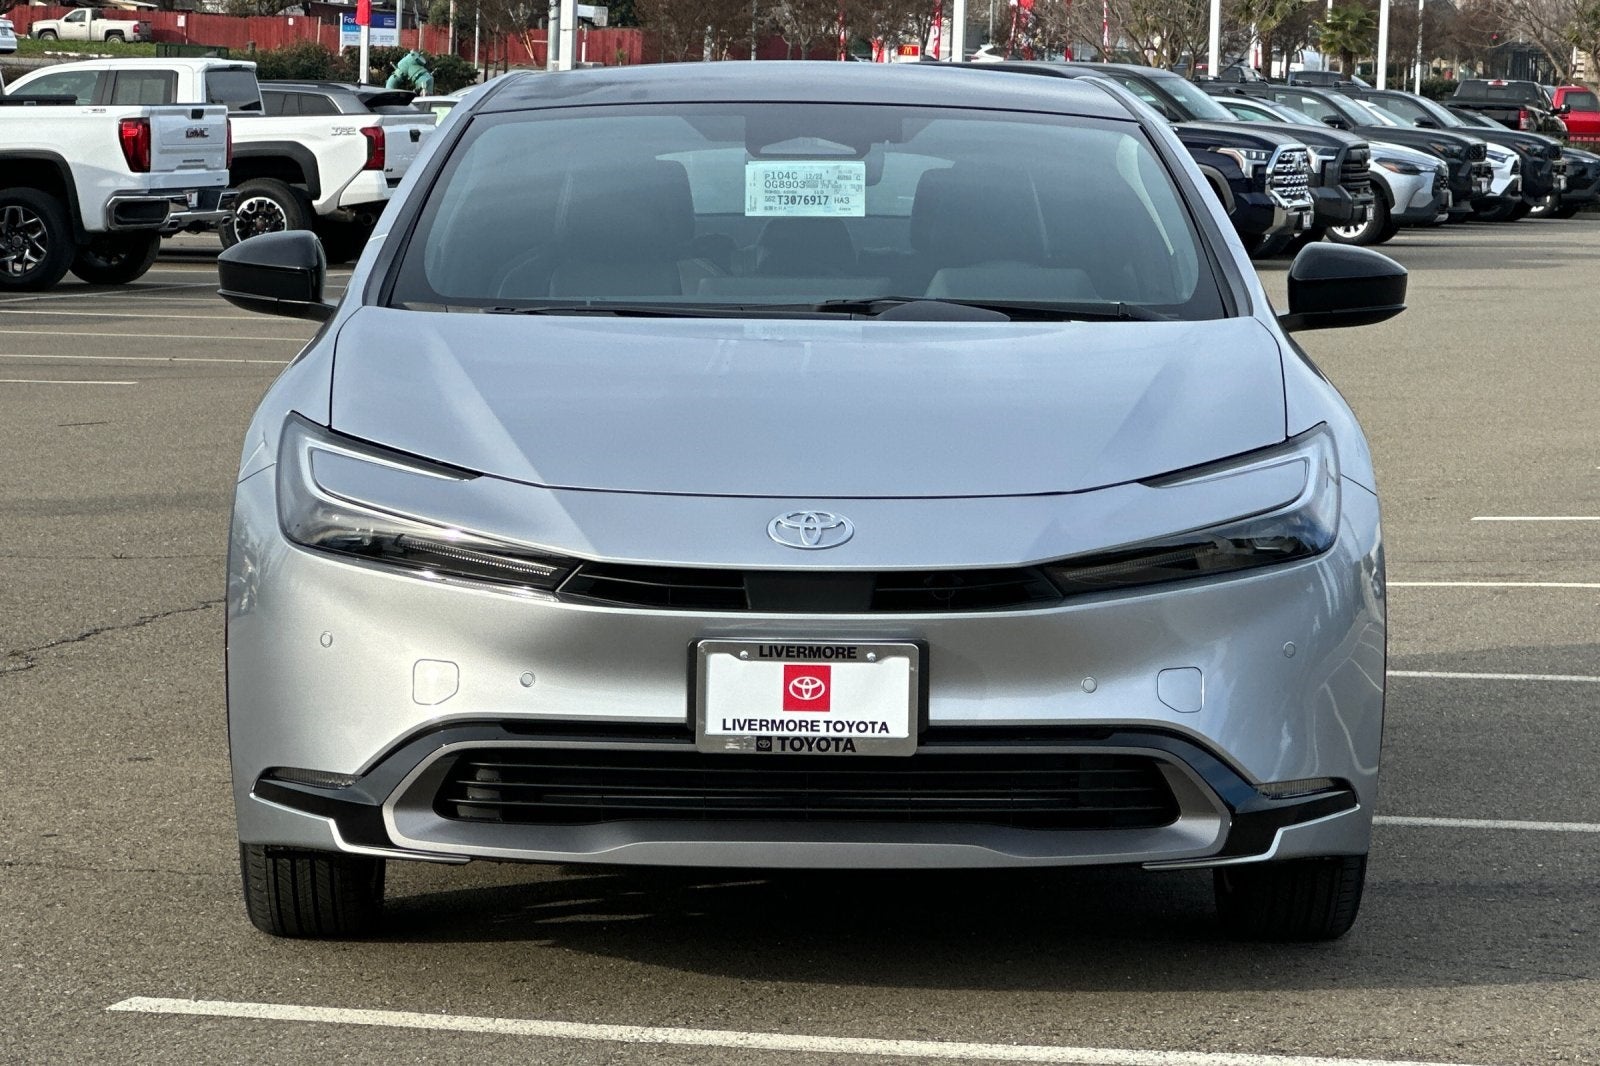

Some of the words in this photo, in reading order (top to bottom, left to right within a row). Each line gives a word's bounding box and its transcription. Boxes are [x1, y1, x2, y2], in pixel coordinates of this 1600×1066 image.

[185, 127, 209, 139] GMC
[764, 171, 798, 180] P104C
[777, 195, 829, 206] T3076917
[834, 196, 850, 204] HA3
[758, 644, 858, 660] LIVERMORE
[722, 718, 821, 733] LIVERMORE
[823, 720, 890, 734] TOYOTA
[776, 736, 857, 753] TOYOTA
